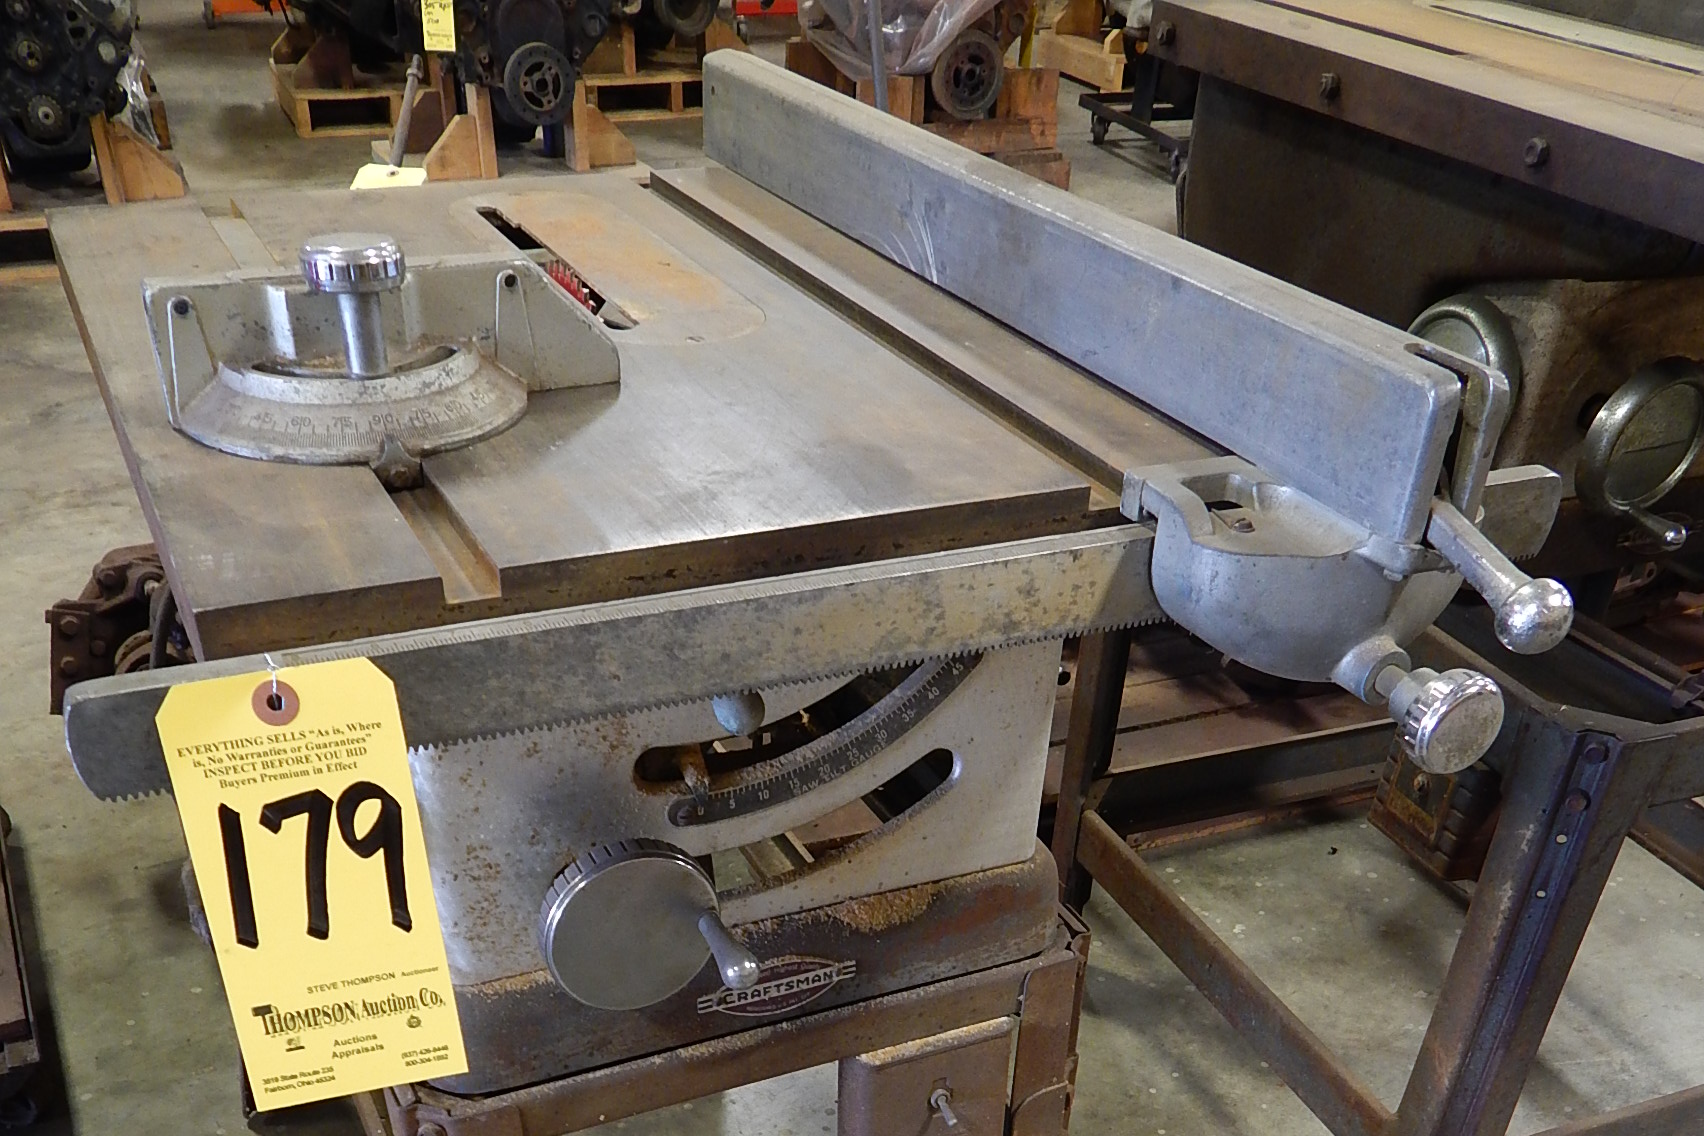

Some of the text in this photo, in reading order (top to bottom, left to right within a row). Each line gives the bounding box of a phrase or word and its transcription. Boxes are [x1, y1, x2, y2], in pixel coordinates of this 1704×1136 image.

[291, 415, 311, 427] 60
[332, 416, 352, 428] 75
[372, 413, 393, 424] 90
[177, 736, 264, 758] EVERYTHING
[267, 730, 306, 744] SELLS
[332, 726, 345, 735] is,
[346, 721, 382, 732] Where
[193, 733, 372, 768] is, No Warranties or Guarantees”
[729, 799, 736, 809] 5
[758, 789, 769, 800] 10
[788, 777, 800, 789] 15
[818, 764, 831, 776] 20
[847, 748, 859, 760] 25
[875, 730, 887, 740] 30
[902, 709, 914, 722] 35
[928, 687, 939, 700] 40
[952, 662, 964, 675] 45
[204, 746, 367, 778] INSPECT BEFORE YOU BID
[219, 761, 358, 789] Buyers Premium in Effect
[793, 741, 887, 796] SAW TILT GAUGE
[218, 781, 412, 949] 179
[306, 966, 439, 994] STEVE THOMPSON Auctioneer
[723, 970, 833, 1005] CRAFTSMAN
[361, 993, 418, 1018] Auction
[419, 987, 444, 1008] Co.
[332, 1043, 385, 1059] Appraisals
[333, 1034, 378, 1047] Auctions
